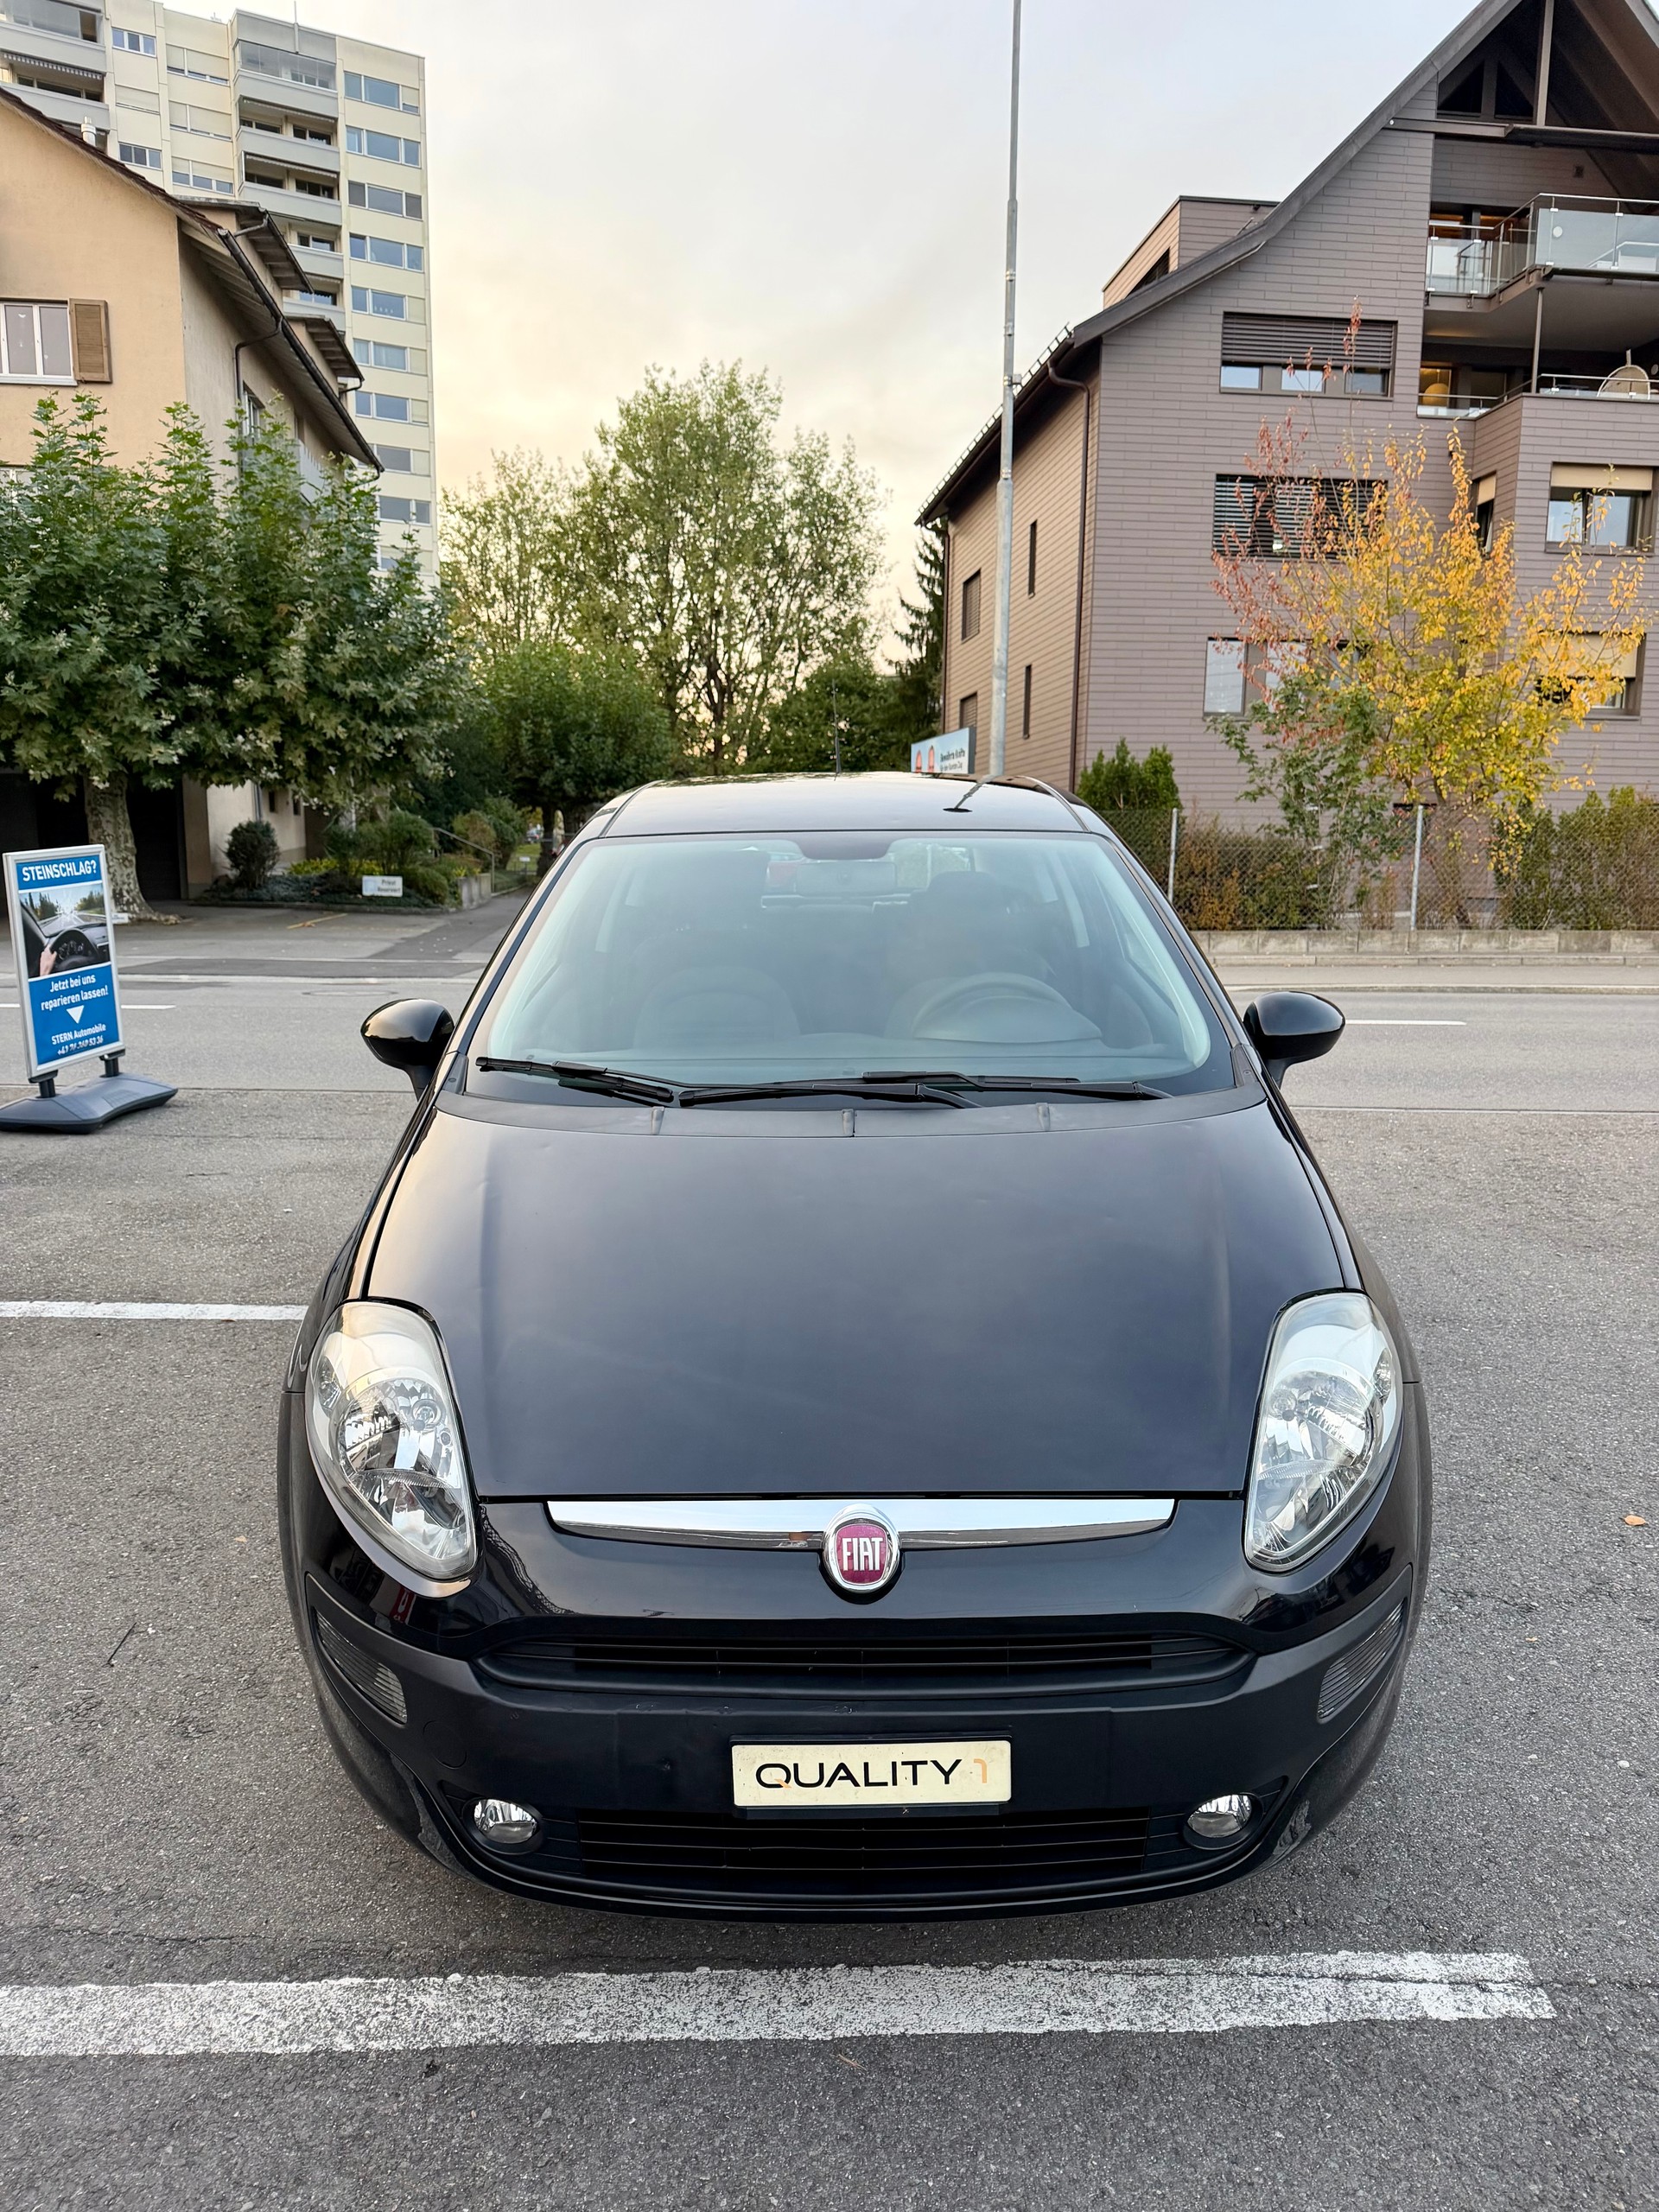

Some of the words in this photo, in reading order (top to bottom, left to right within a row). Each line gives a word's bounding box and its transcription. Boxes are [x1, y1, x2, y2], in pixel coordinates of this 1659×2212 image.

[22, 860, 97, 881] STEINSCHLAG?
[49, 979, 69, 993] Jetzt
[69, 976, 81, 988] bei
[81, 974, 96, 985] uns
[41, 994, 80, 1011] reparieren
[80, 985, 109, 1001] lassen!
[51, 1030, 73, 1045] STERN
[73, 1023, 106, 1039] Automobile
[842, 1537, 883, 1572] FIAT
[755, 1758, 963, 1789] QUALITY
[973, 1758, 988, 1784] 1
